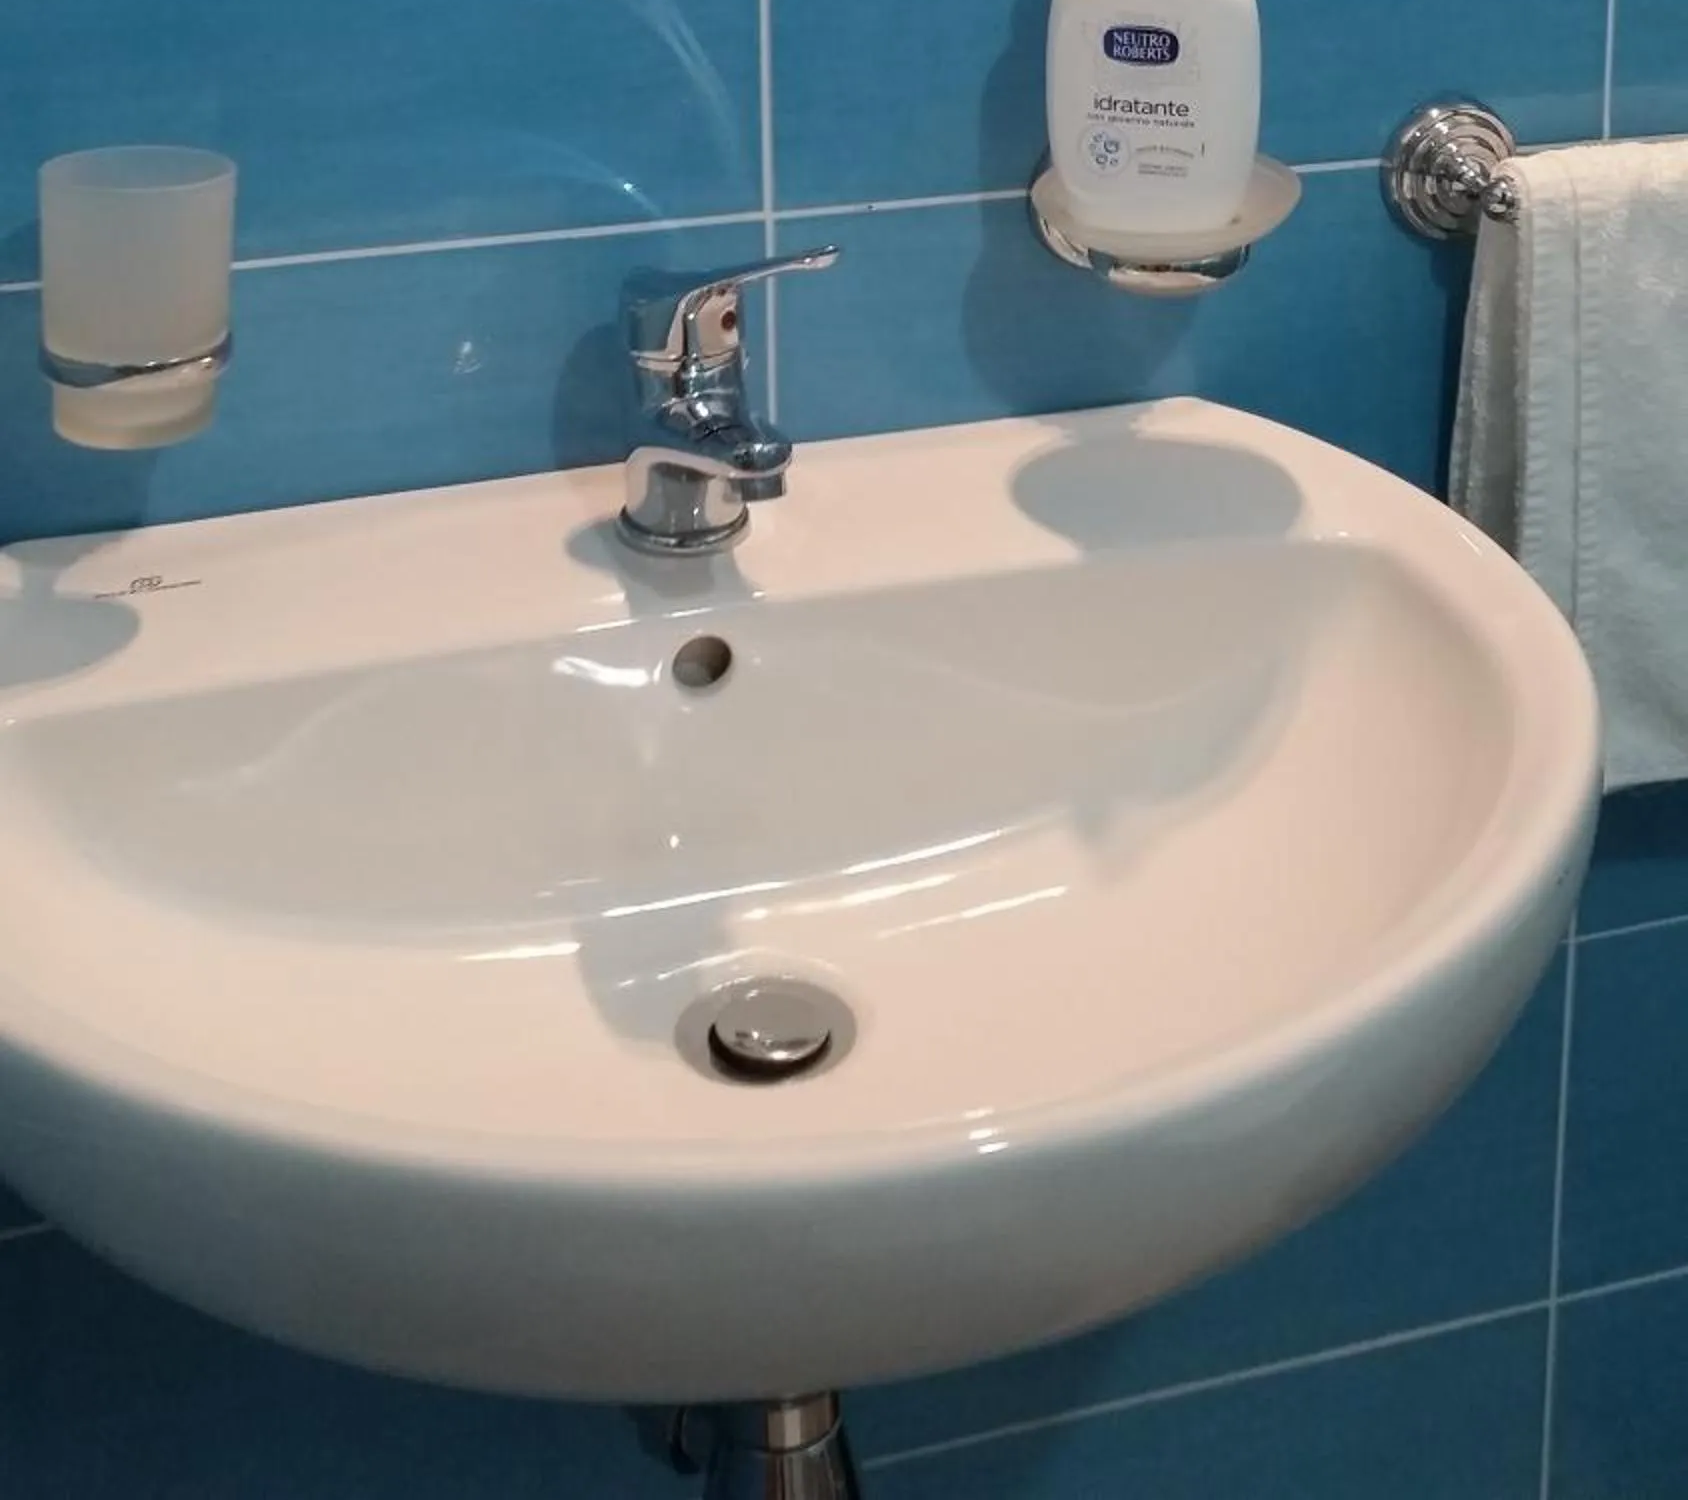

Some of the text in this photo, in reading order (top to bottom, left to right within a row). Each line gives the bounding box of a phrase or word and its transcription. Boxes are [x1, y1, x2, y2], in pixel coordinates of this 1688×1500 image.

[1113, 31, 1171, 47] NEUTRO
[1113, 45, 1171, 61] ROBERTS
[1093, 93, 1190, 117] idratante
